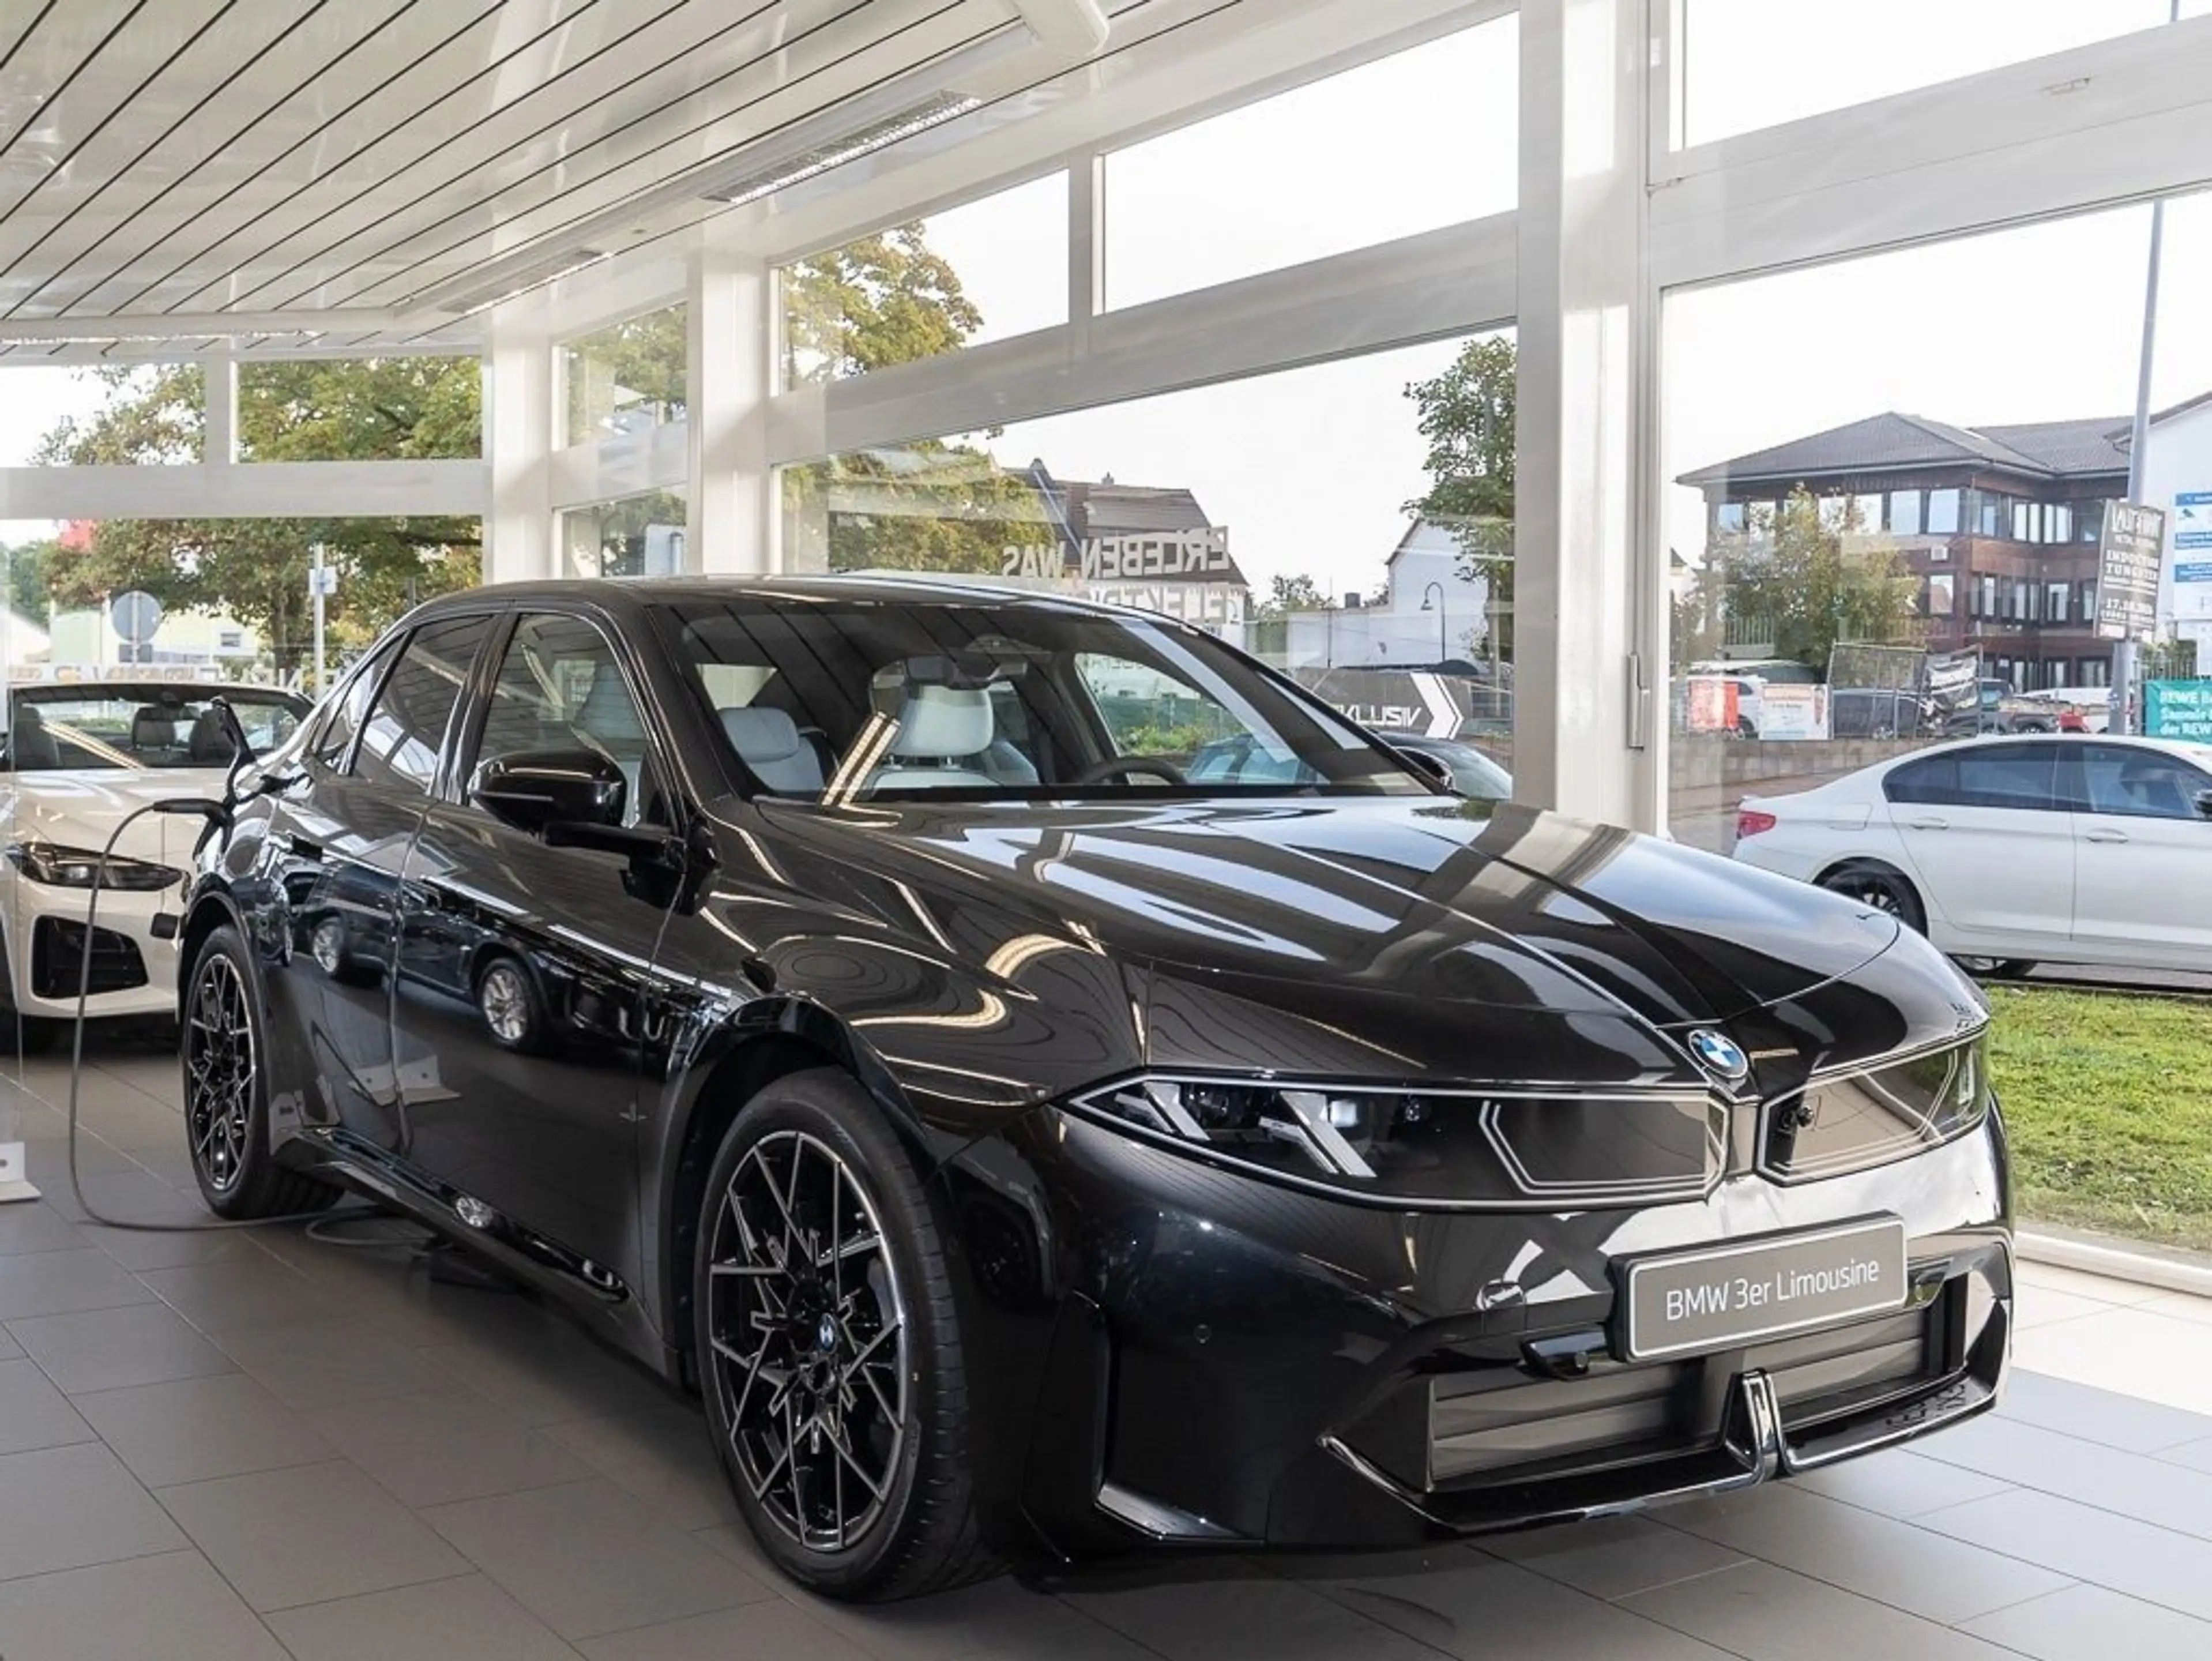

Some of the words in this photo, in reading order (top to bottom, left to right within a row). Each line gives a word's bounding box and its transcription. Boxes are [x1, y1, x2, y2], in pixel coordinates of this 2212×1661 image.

[1666, 1281, 1729, 1321] BMW
[1735, 1277, 1772, 1310] 3er
[1777, 1258, 1880, 1301] Limousine
